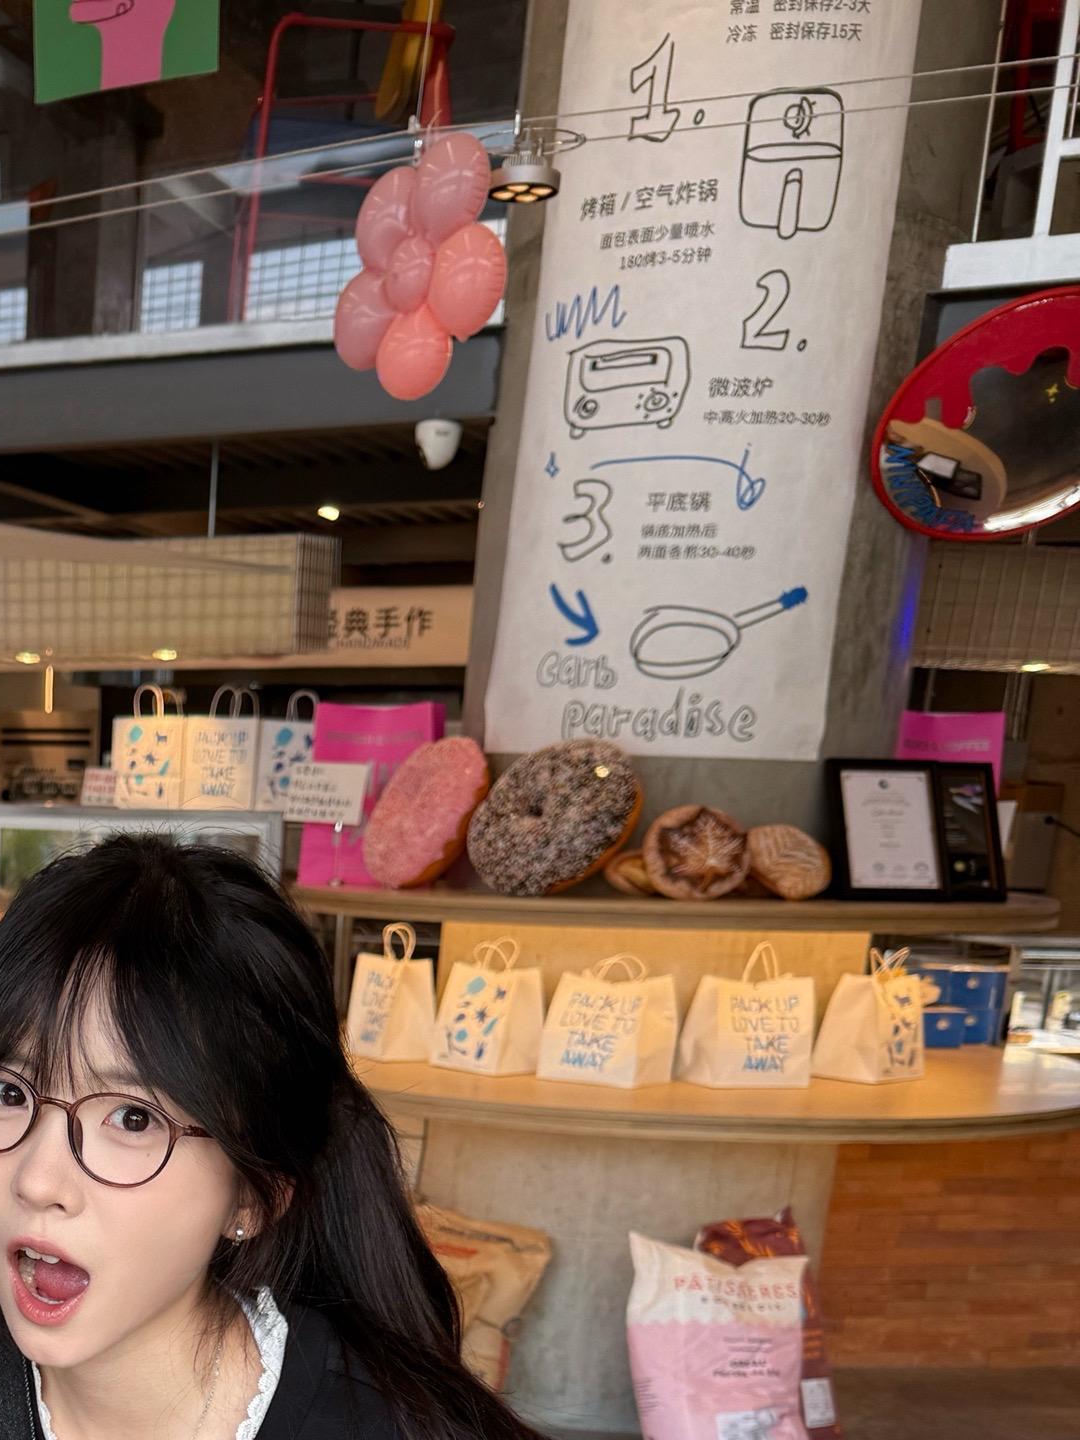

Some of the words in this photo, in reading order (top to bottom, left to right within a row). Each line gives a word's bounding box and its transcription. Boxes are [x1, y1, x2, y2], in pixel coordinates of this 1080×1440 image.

[726, 24, 758, 43] 冷冻
[770, 21, 863, 41] 密封保存15天
[580, 193, 618, 221] 烤箱
[634, 178, 719, 211] 空气炸锅
[708, 376, 774, 399] 微波炉
[561, 687, 758, 744] paradise
